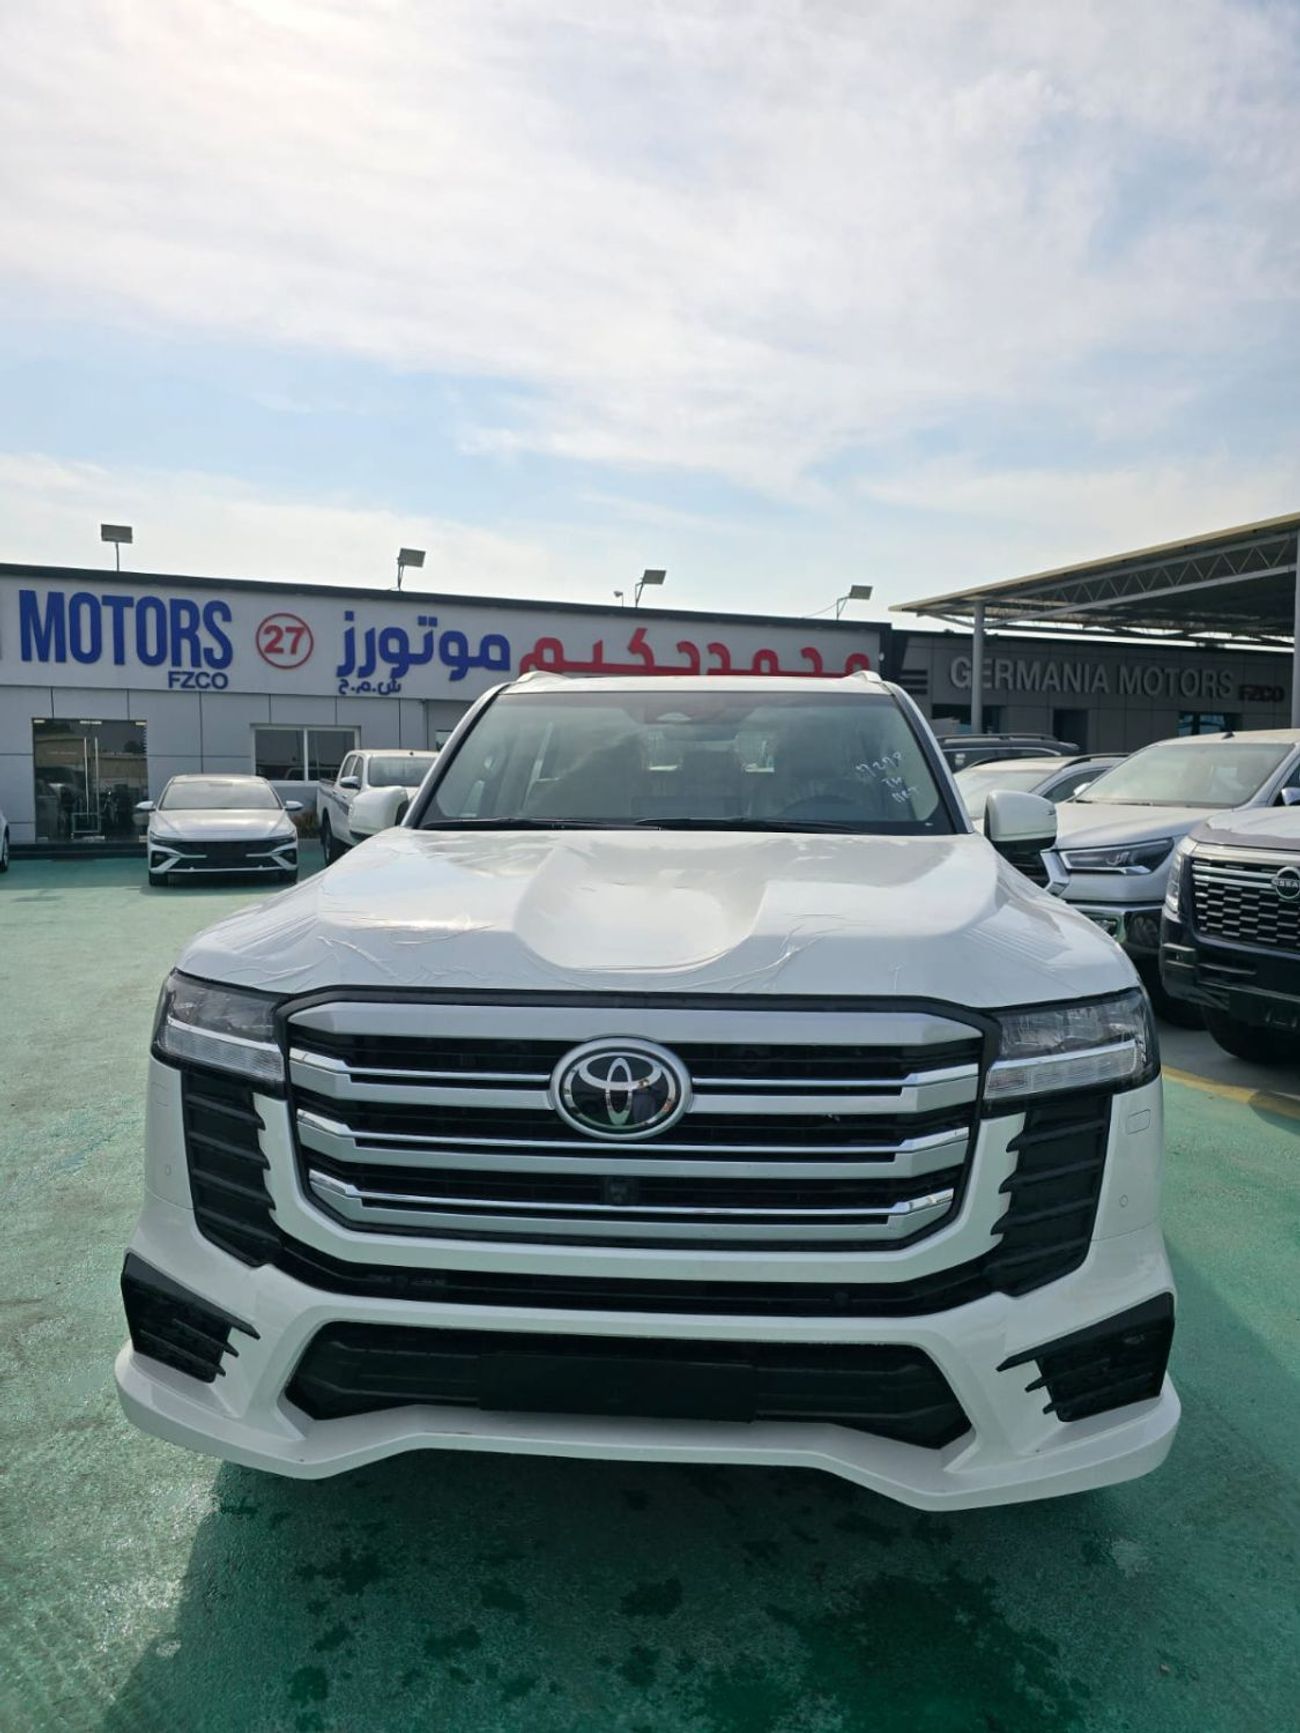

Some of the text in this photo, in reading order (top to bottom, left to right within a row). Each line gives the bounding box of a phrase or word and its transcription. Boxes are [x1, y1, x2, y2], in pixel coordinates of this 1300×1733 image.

[19, 589, 234, 670] MOTORS
[263, 624, 306, 655] 27
[336, 611, 511, 681] موتورز
[168, 671, 229, 690] FZCO
[950, 656, 1234, 698] GERMANIA MOTORS
